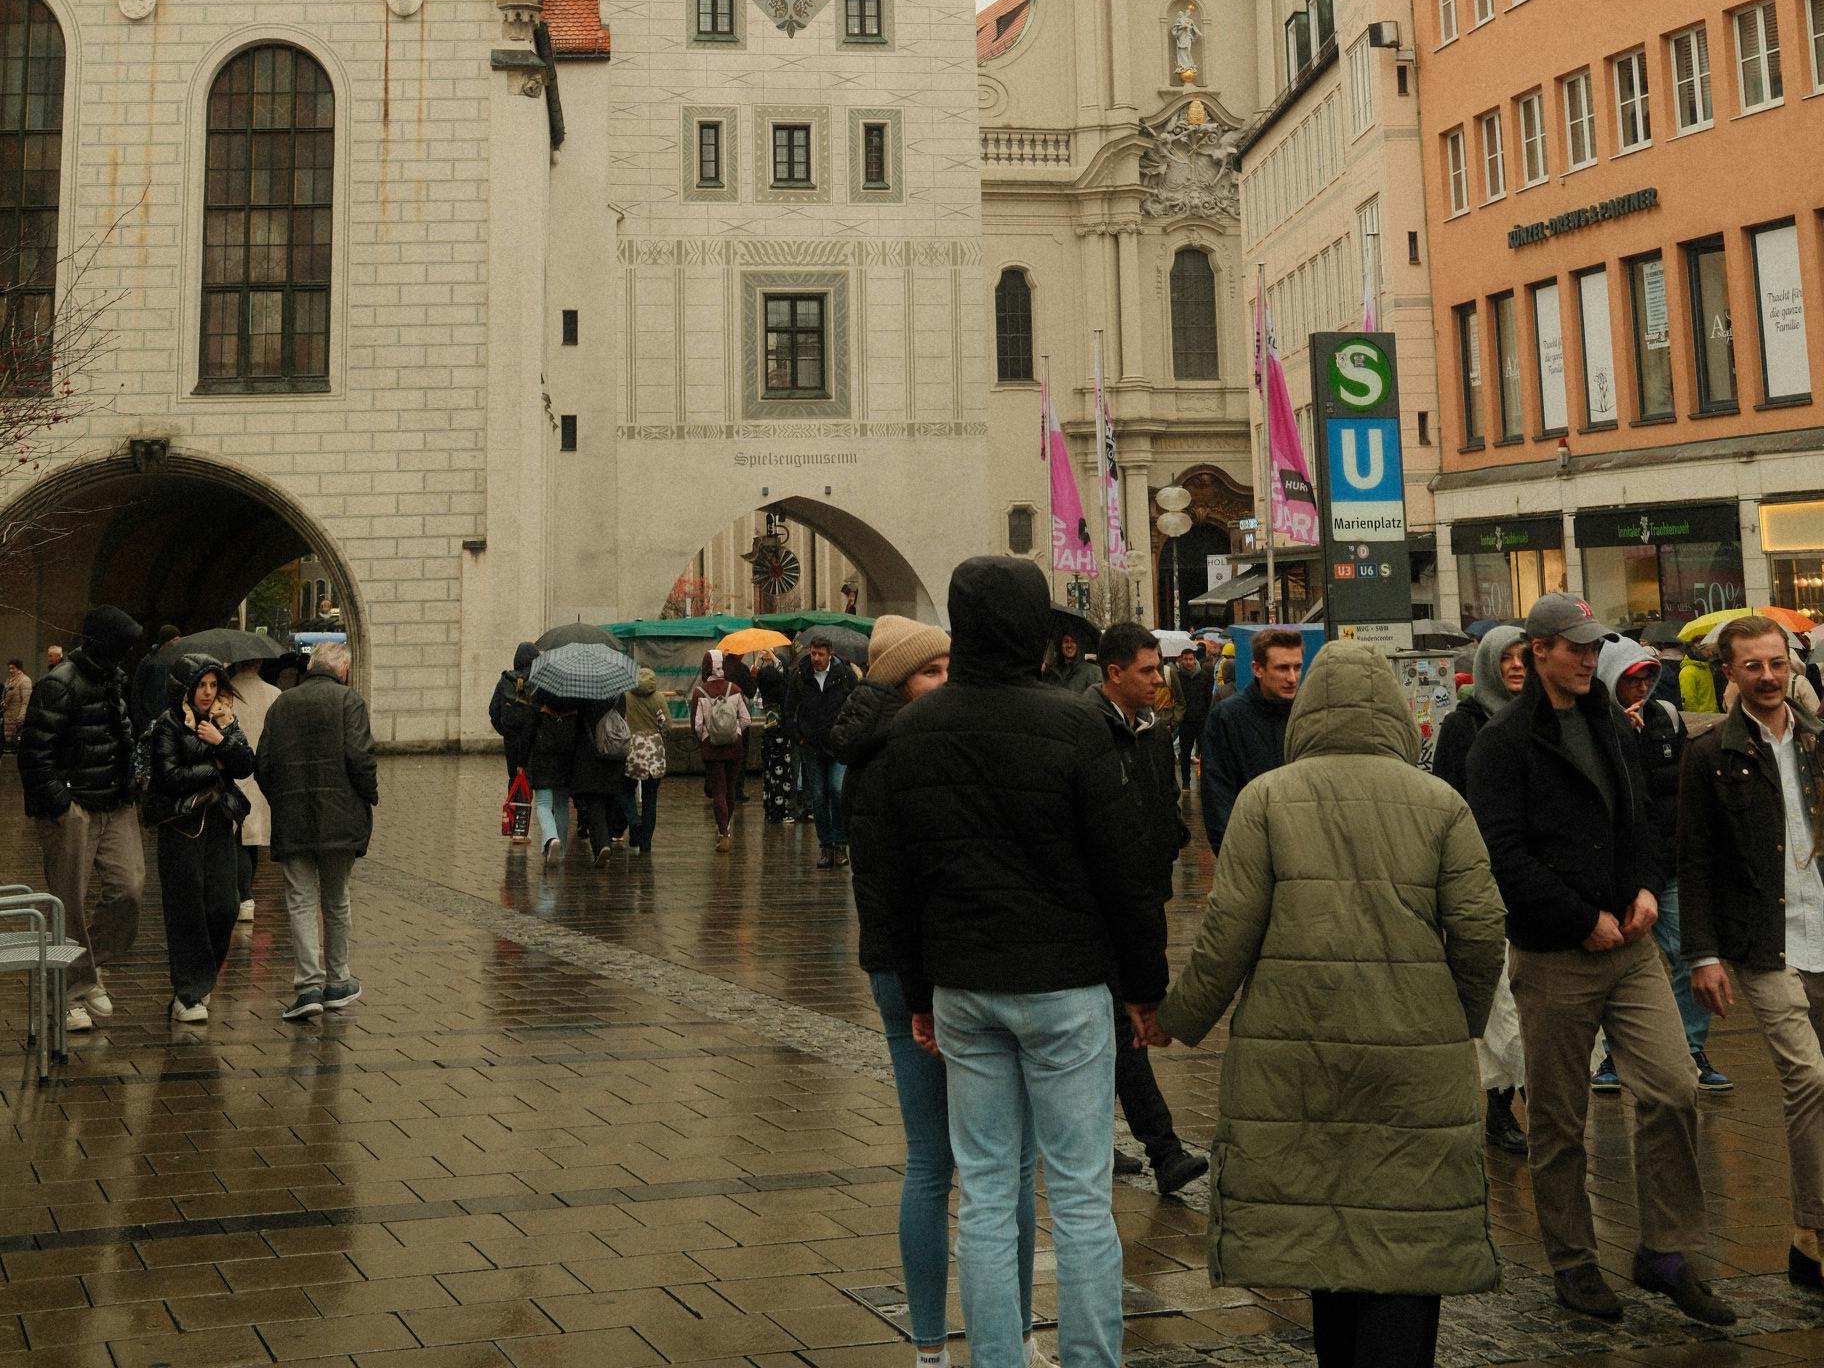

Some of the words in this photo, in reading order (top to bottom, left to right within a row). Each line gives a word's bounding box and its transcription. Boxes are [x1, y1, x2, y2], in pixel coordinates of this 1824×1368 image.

[1599, 187, 1659, 219] PARTNER
[1336, 345, 1382, 406] S
[734, 452, 857, 468] Spielzeugmuseum
[1341, 428, 1384, 490] U
[1334, 517, 1402, 531] Marienplatz
[1207, 558, 1226, 566] HOL
[1337, 565, 1351, 576] U3
[1360, 565, 1374, 576] U6
[1380, 563, 1390, 577] S
